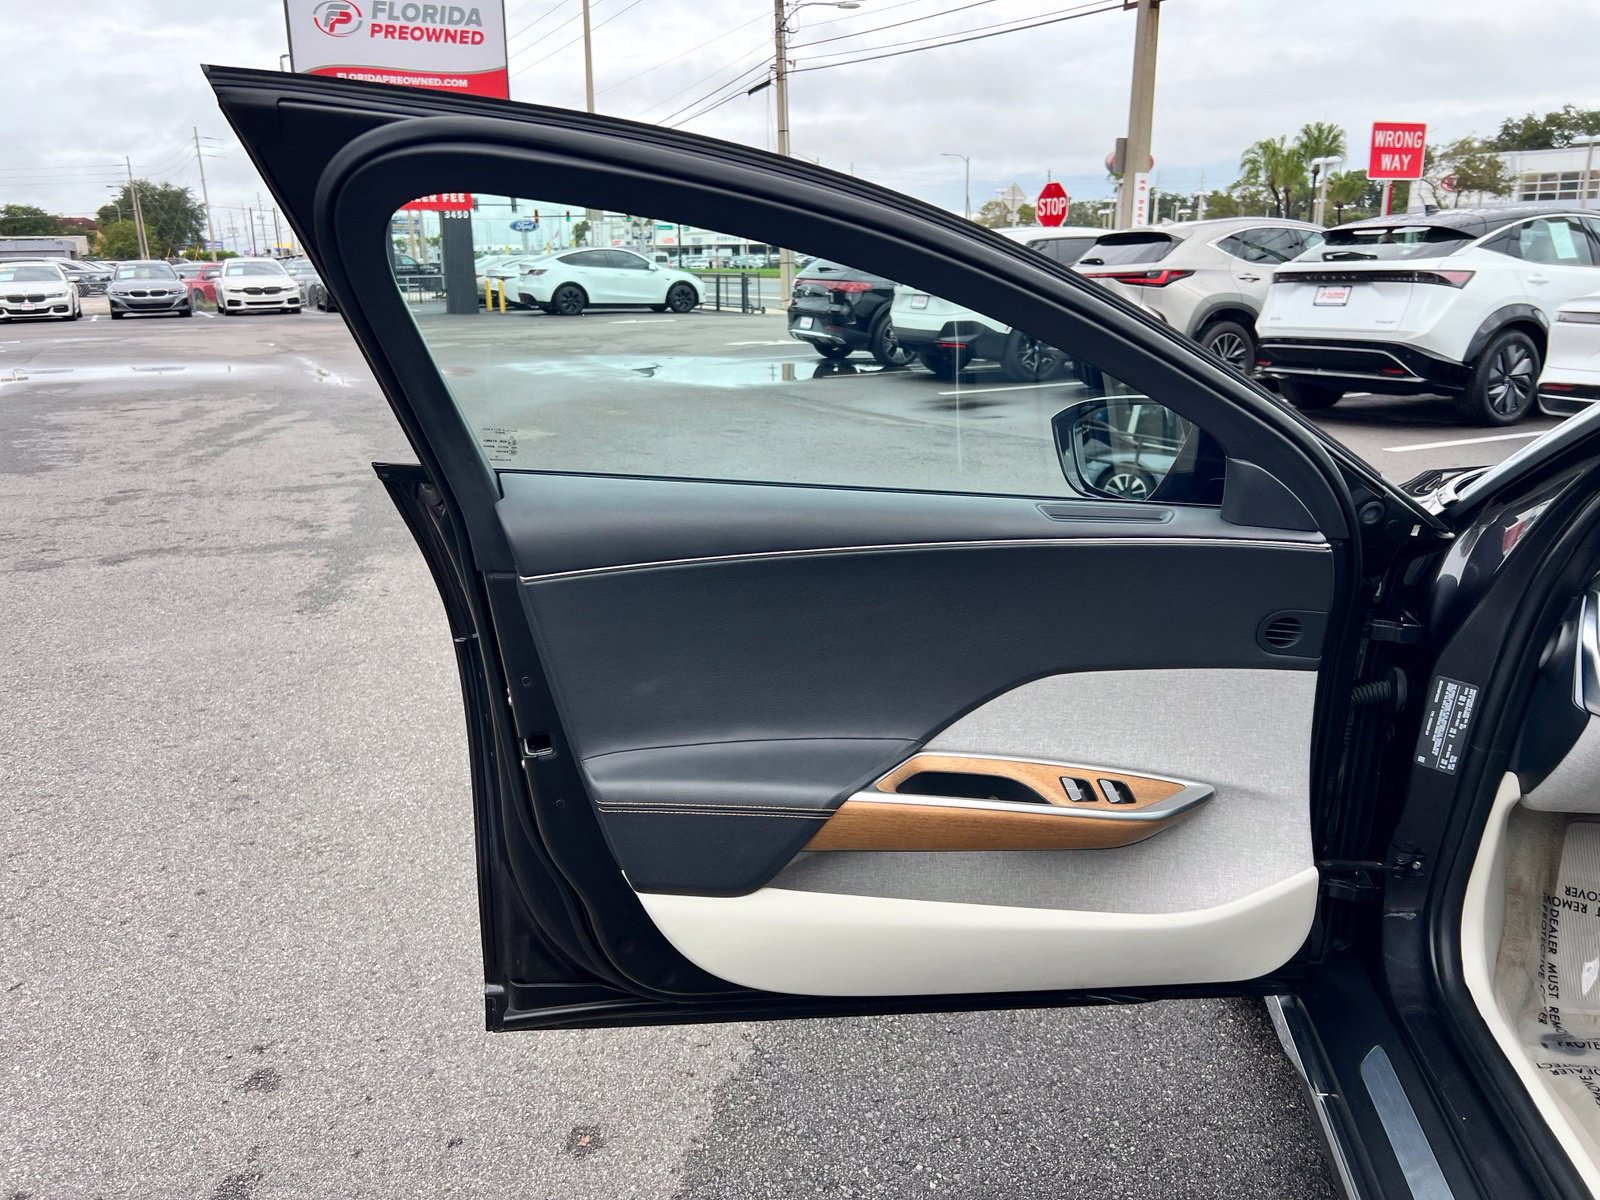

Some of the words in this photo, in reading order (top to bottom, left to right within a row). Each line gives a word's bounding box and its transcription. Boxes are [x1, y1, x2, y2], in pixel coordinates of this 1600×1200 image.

[371, 0, 483, 28] FLORIDA
[369, 23, 485, 46] PREOWNED
[336, 72, 469, 88] FLORIDAPREOWNED.COM
[1375, 130, 1423, 149] WRONG
[1381, 153, 1412, 171] WAY
[442, 193, 466, 203] FEE
[1038, 197, 1066, 217] STOP
[1563, 885, 1600, 903] OVER
[1547, 908, 1560, 955] DEALER
[1547, 962, 1560, 999] MUST
